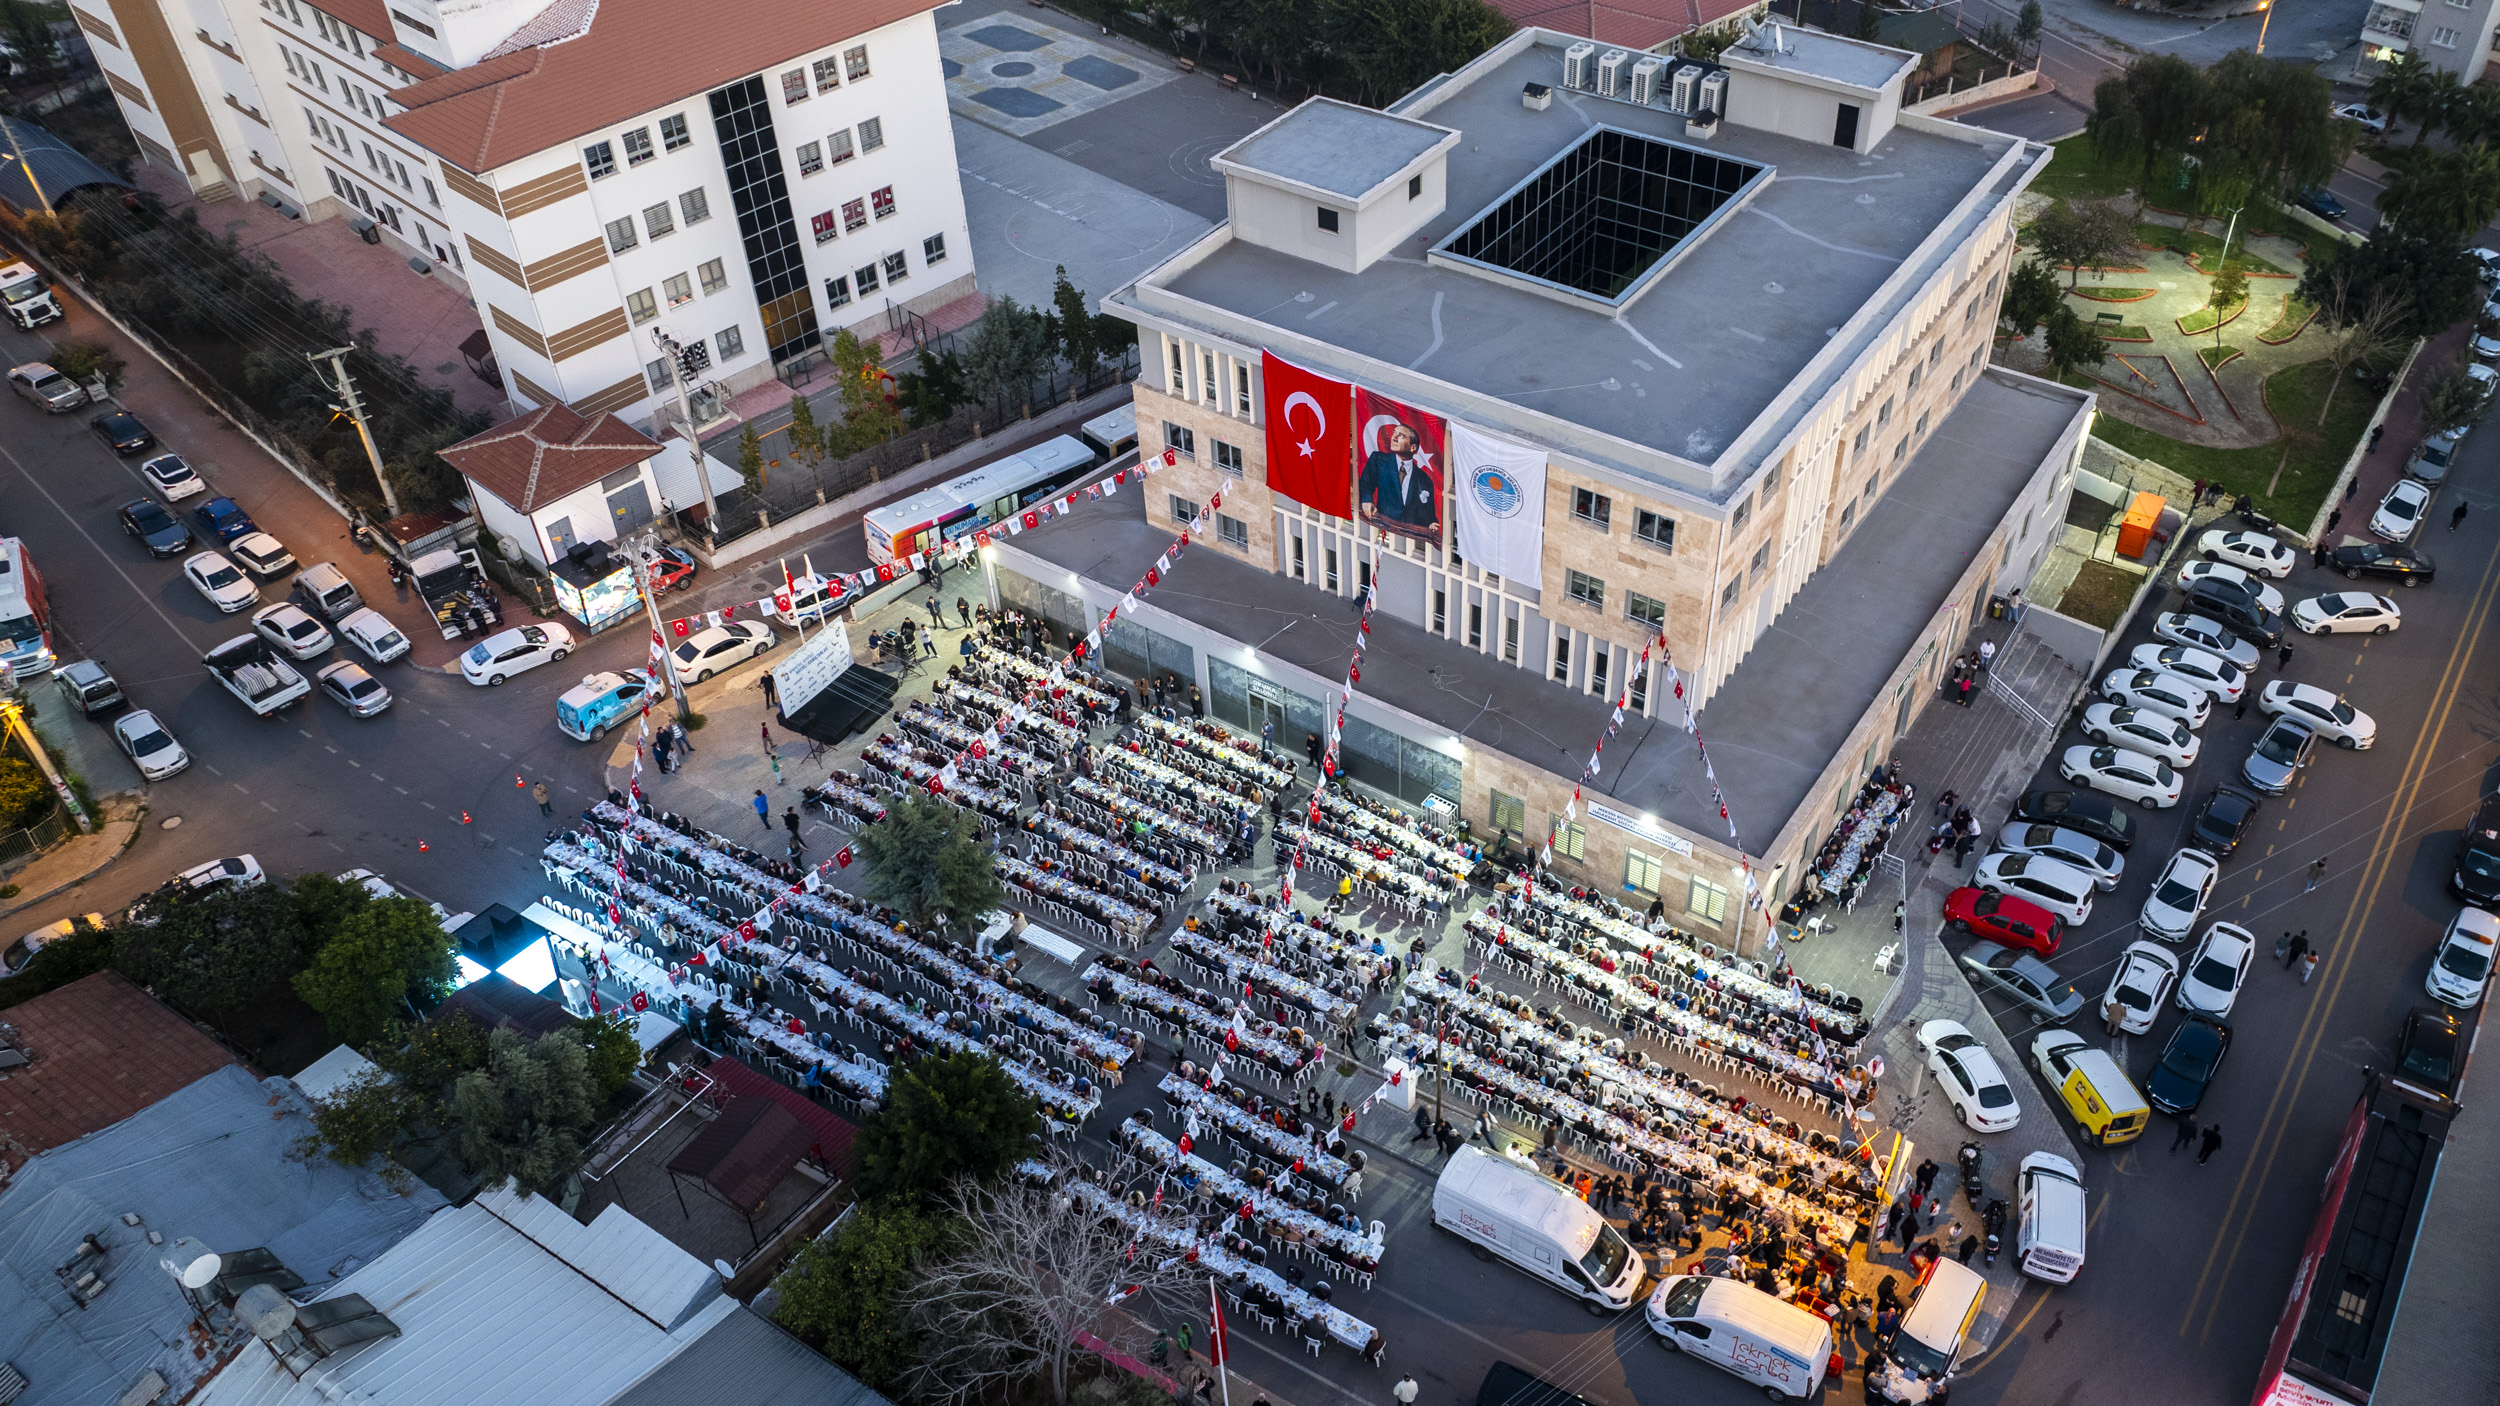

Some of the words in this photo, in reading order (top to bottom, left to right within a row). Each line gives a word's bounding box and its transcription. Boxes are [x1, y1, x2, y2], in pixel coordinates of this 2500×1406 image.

[1253, 680, 1276, 692] OKUMA
[1253, 686, 1277, 699] SALONU
[2282, 1379, 2305, 1392] Seni
